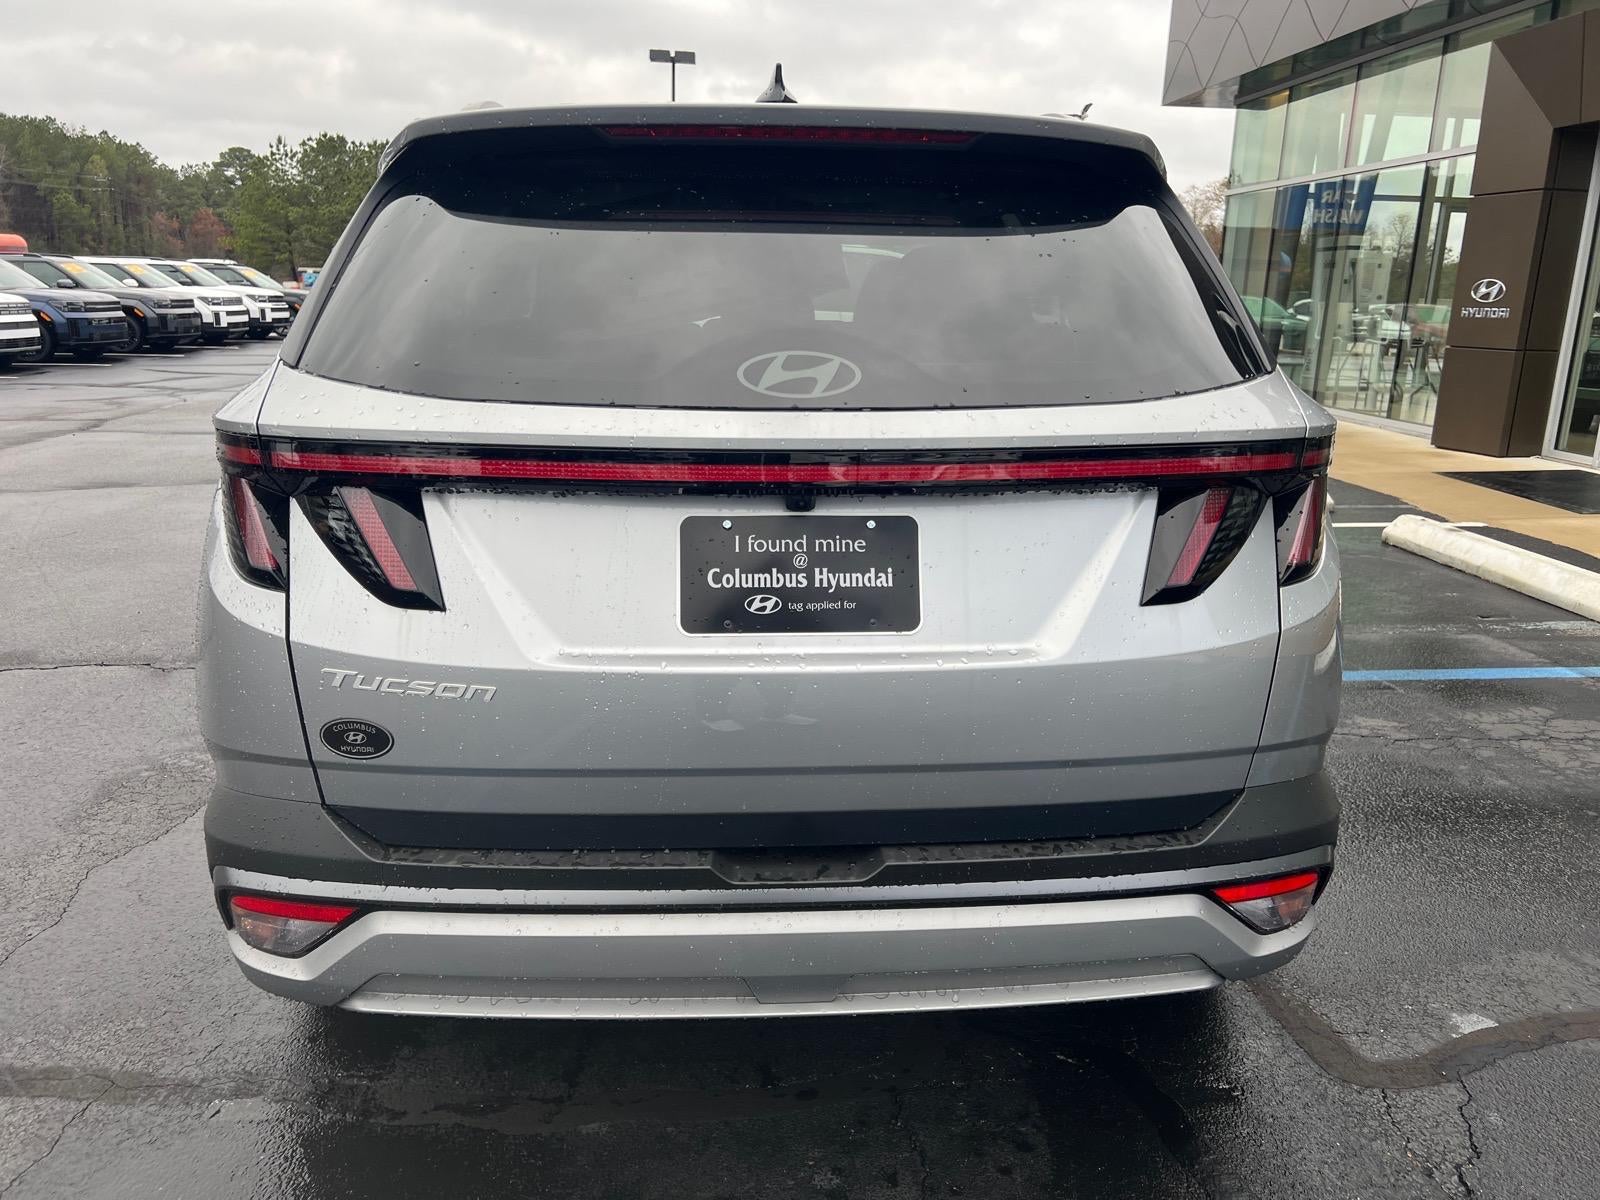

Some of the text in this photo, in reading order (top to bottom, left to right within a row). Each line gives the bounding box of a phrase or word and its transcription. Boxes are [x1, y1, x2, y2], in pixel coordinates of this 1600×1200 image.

[1461, 307, 1510, 318] HYUNDAI
[734, 534, 867, 553] I found mine
[793, 553, 808, 569] @
[706, 567, 894, 593] Columbus Hyundai
[788, 600, 857, 611] tag applied for
[332, 722, 376, 734] COLUMBUS
[340, 745, 375, 753] HYUNDAI
